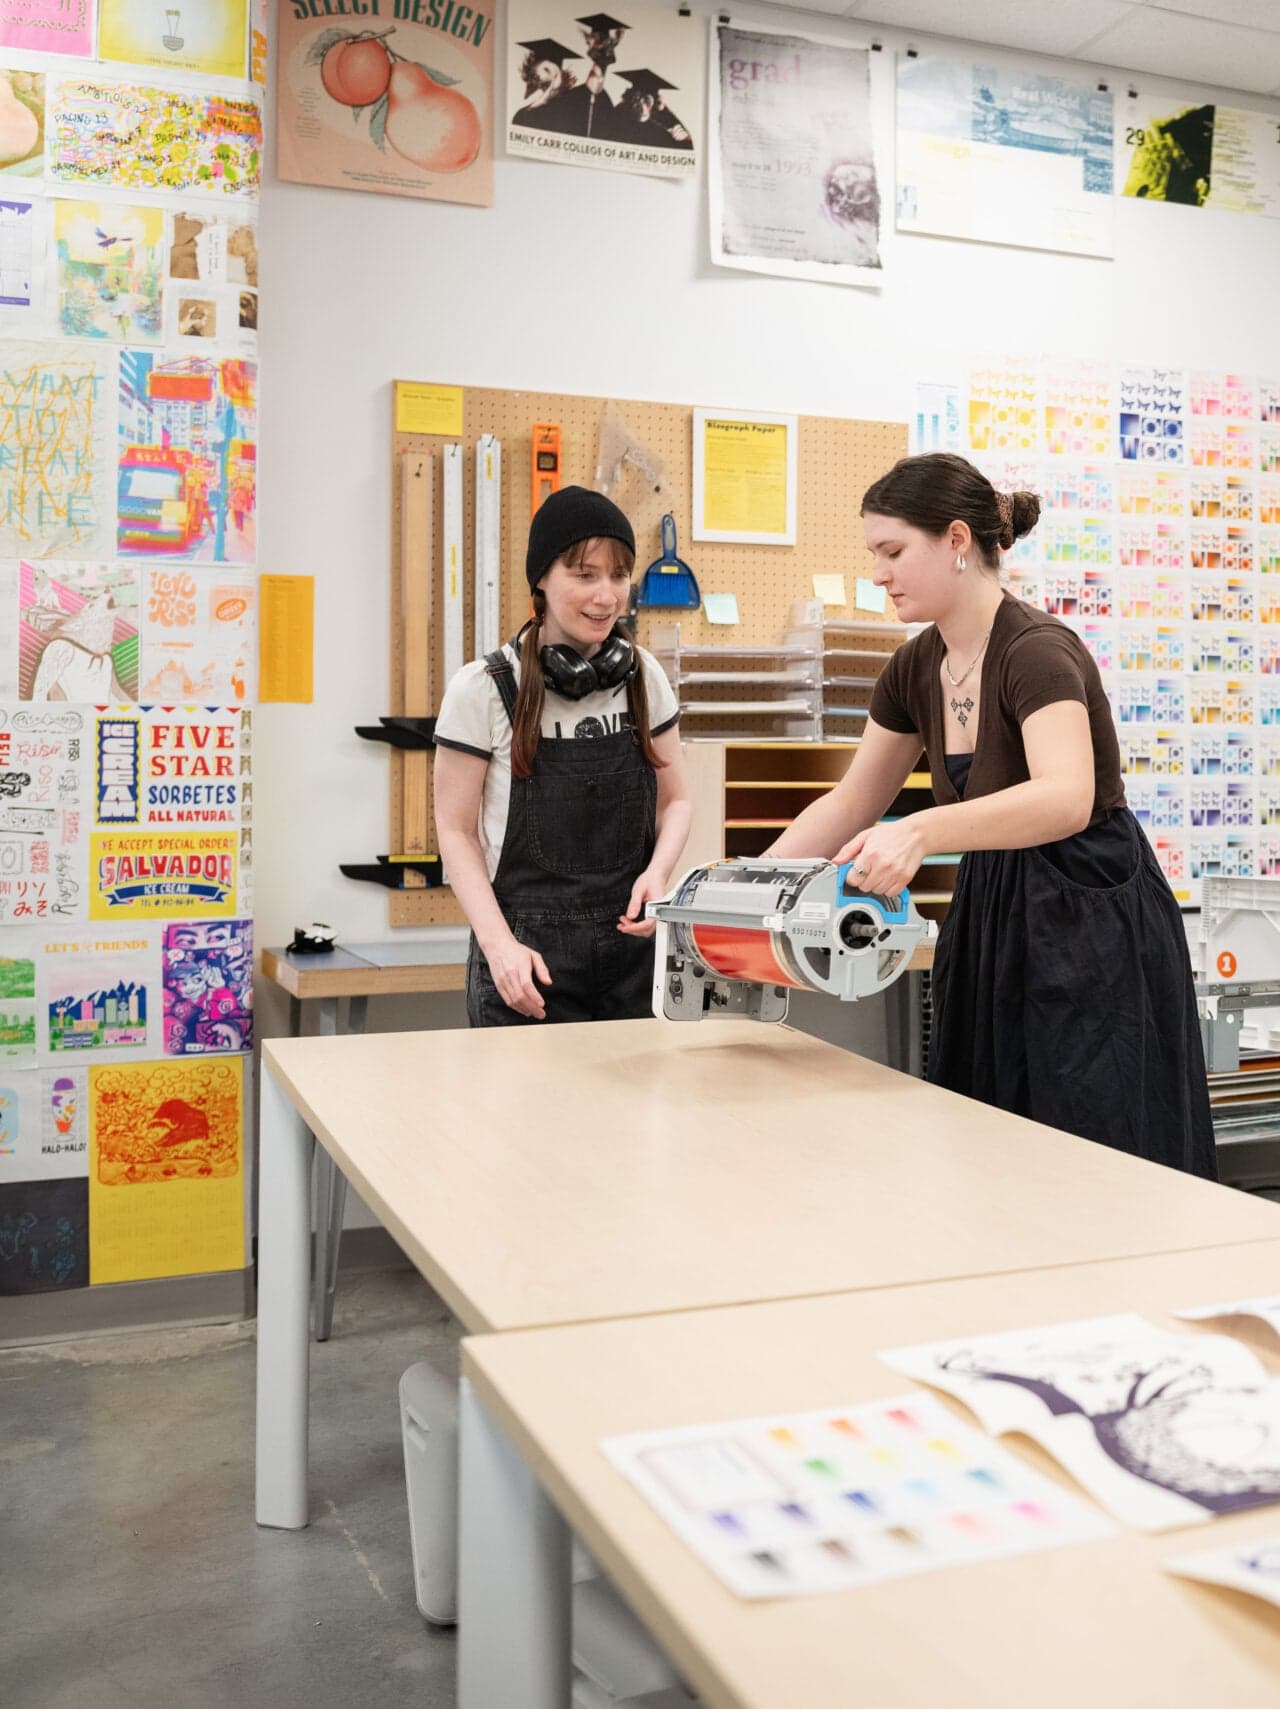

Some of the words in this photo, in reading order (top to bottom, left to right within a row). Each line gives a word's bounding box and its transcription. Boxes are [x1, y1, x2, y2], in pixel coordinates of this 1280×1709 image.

[294, 0, 380, 20] SELECT
[393, 0, 492, 48] DESIGN
[1126, 127, 1145, 147] 29
[510, 132, 535, 145] EMILY
[537, 136, 561, 150] CARR
[563, 142, 601, 156] COLLEGE
[604, 149, 616, 158] OF
[618, 151, 635, 161] ART
[638, 154, 658, 163] AND
[660, 155, 695, 167] DESIGN
[151, 725, 235, 749] FIVE
[151, 754, 235, 777] STAR
[149, 785, 237, 805] SORBETES
[149, 811, 173, 822] ALL
[177, 810, 235, 822] NATURAL
[118, 840, 154, 851] ACCEPT
[158, 839, 195, 850] SPECIAL
[100, 853, 233, 891] SALVADOR
[1221, 958, 1234, 973] 1
